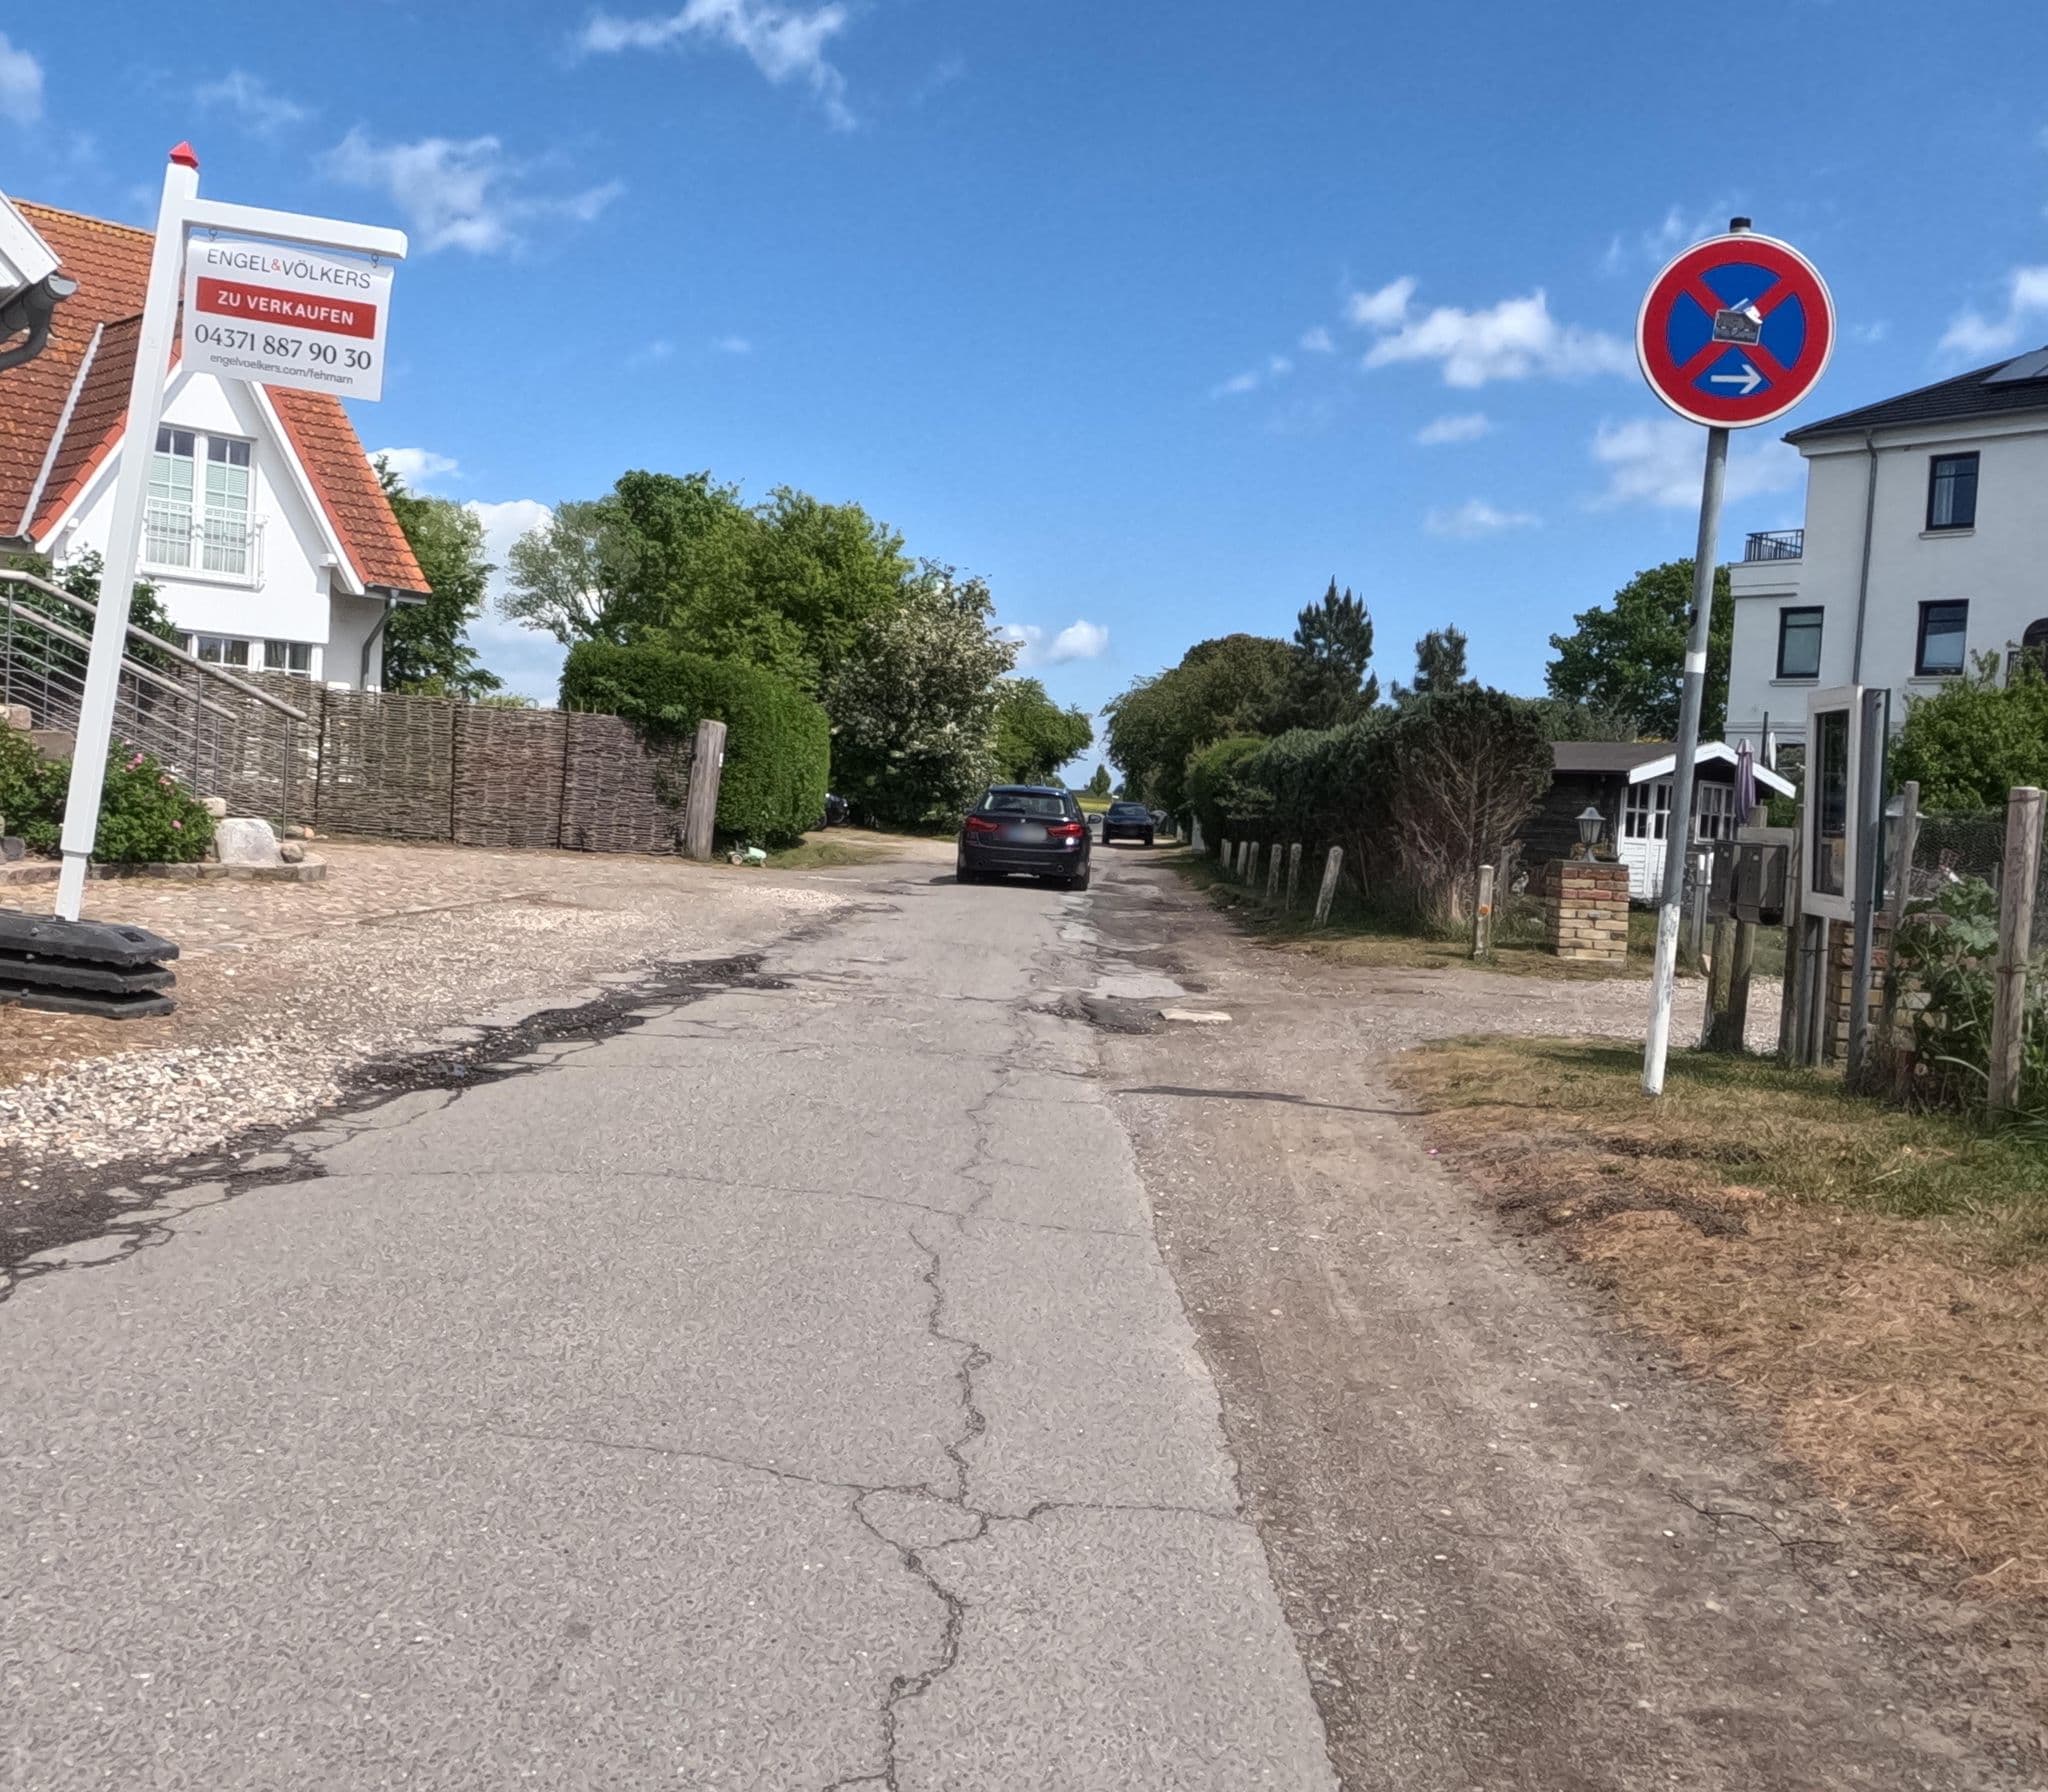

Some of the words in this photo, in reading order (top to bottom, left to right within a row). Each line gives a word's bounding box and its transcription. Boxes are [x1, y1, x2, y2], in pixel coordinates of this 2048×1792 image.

[207, 249, 371, 289] ENGEL&VÖLKERS
[217, 290, 240, 307] ZU
[247, 295, 354, 326] VERKAUFEN
[195, 324, 255, 351] 04371
[263, 335, 302, 358] 887
[309, 343, 337, 364] 90
[344, 349, 371, 370] 30
[210, 353, 353, 385] engelvoelkers.com/fehmarn
